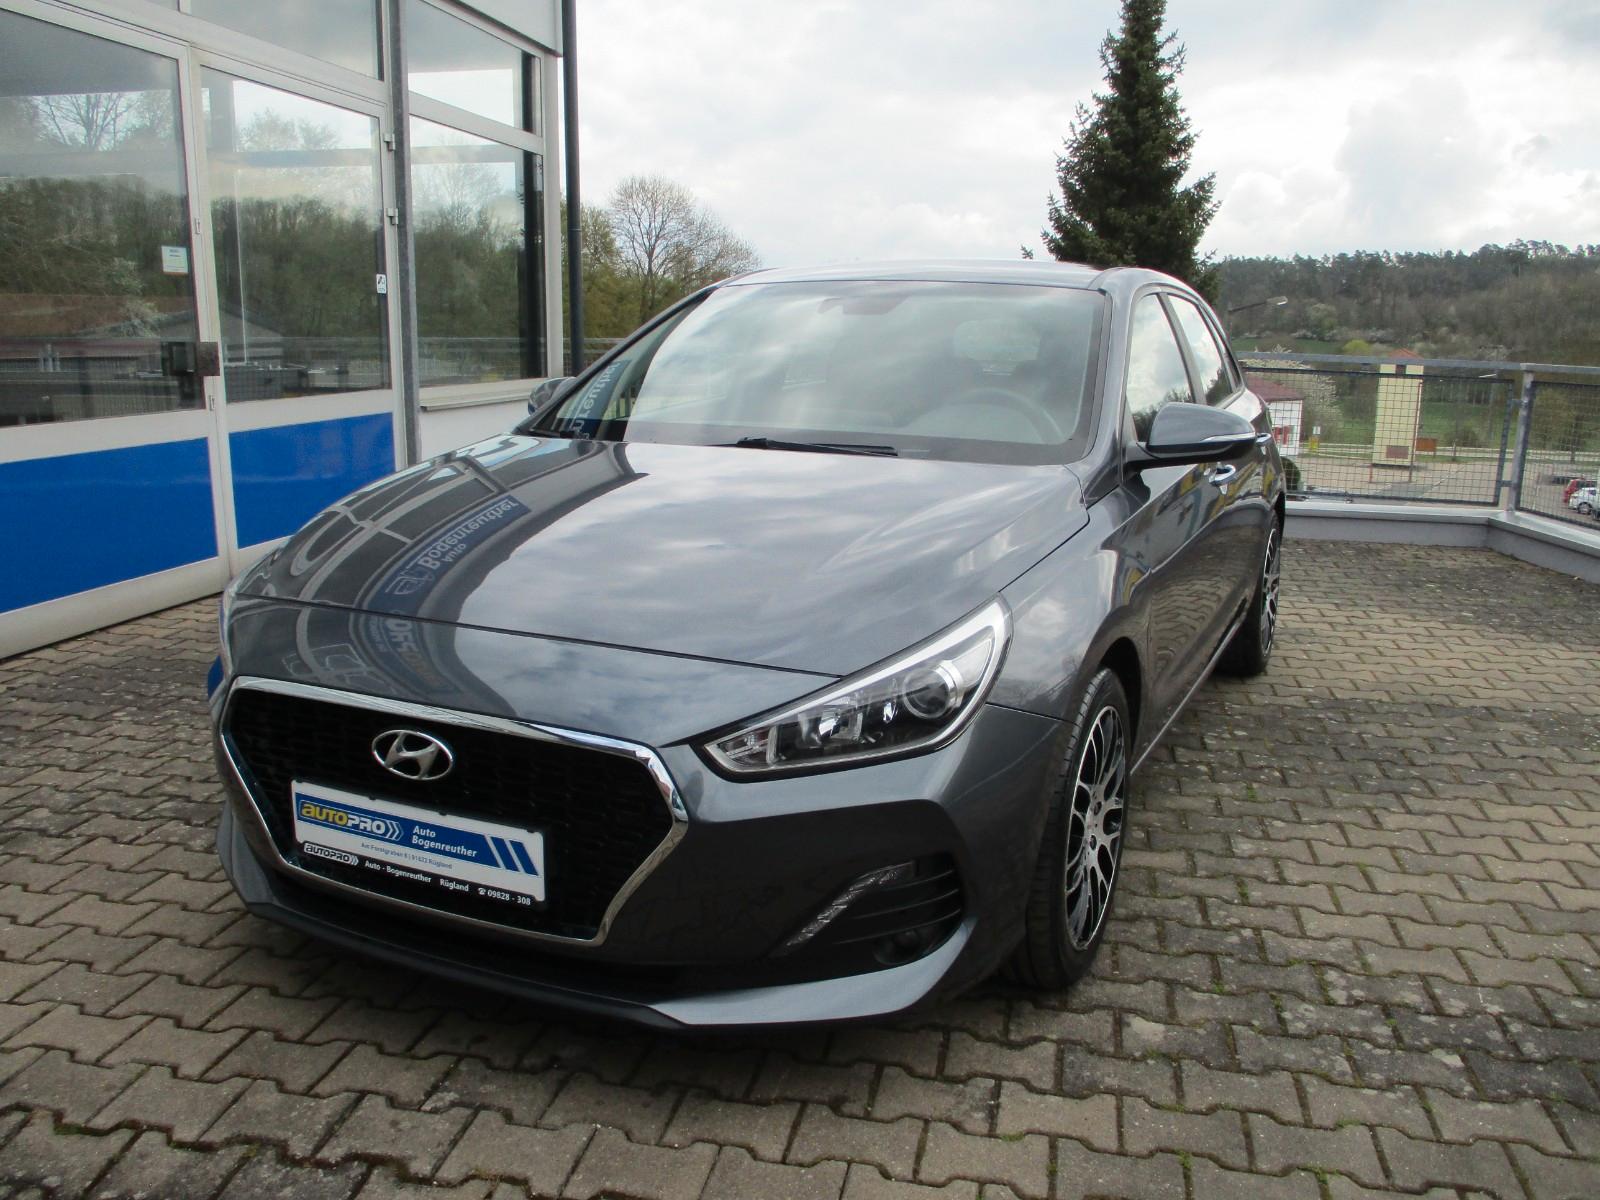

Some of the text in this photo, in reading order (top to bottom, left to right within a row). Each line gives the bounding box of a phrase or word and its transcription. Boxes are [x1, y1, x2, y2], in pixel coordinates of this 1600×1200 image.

[413, 825, 437, 839] Auto
[412, 835, 478, 858] Bogenreuther
[365, 860, 381, 872] Auto
[386, 864, 432, 884] Bogenreuther
[440, 878, 470, 893] Rügland
[487, 889, 510, 902] 09828
[517, 895, 531, 906] 308
